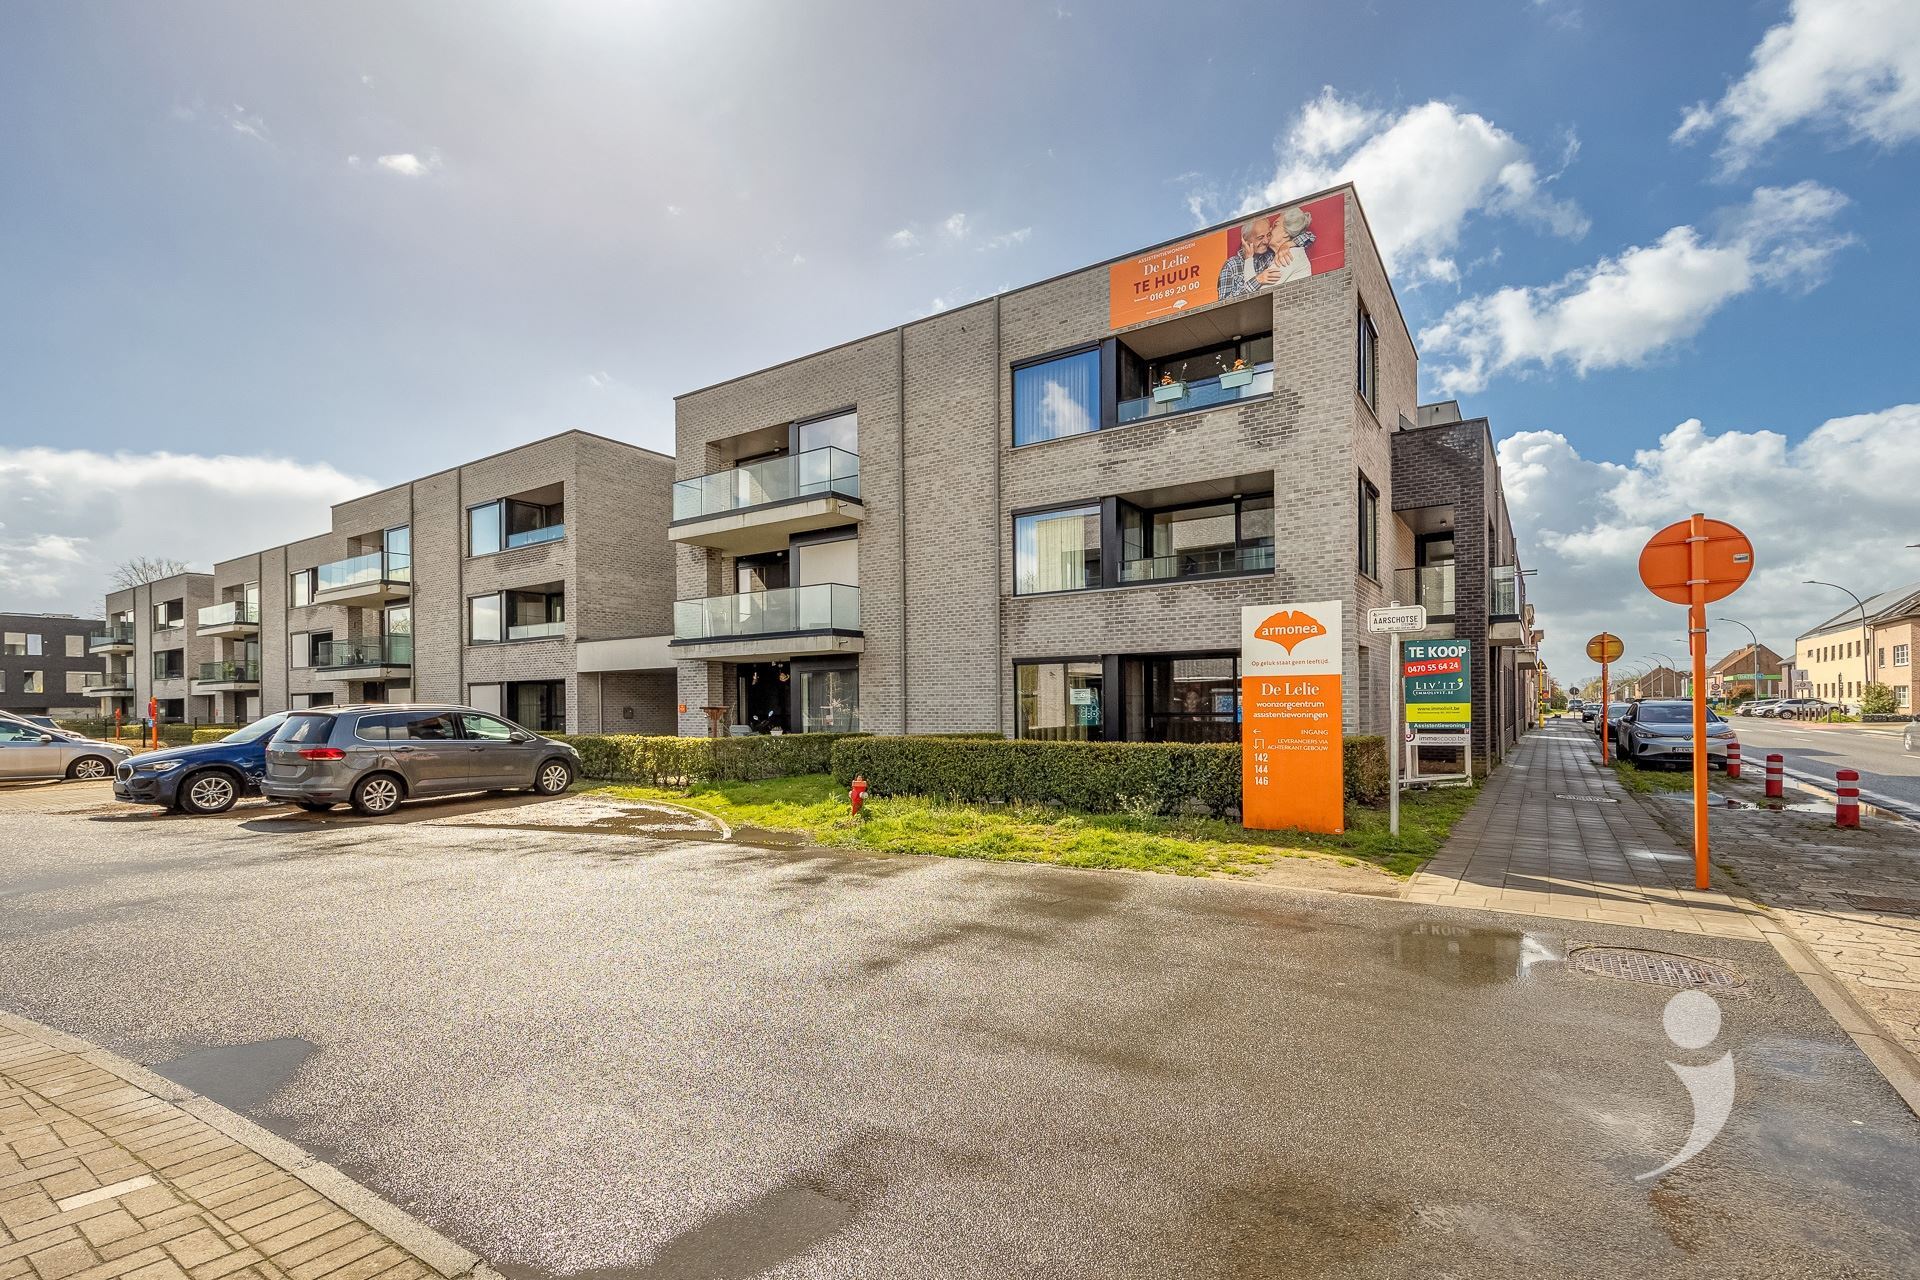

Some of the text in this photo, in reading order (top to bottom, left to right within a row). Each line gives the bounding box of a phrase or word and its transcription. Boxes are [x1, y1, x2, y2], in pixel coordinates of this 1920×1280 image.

[1144, 254, 1189, 275] De Lelie
[1134, 265, 1200, 294] TE HUUR
[1150, 281, 1200, 301] 016 89 20 00
[1373, 615, 1419, 625] AARSCHOTSE
[1261, 625, 1318, 636] armonea
[1408, 646, 1467, 658] TE KOOP
[1260, 659, 1275, 667] geluk
[1292, 659, 1306, 667] geen
[1407, 665, 1426, 673] 0470
[1438, 662, 1448, 670] 64
[1449, 661, 1459, 670] 24
[1261, 682, 1320, 696] De Lelie
[1256, 701, 1325, 710] woonzorgcentrum
[1253, 711, 1329, 721] assistentiewoningen
[1254, 753, 1268, 762] 142
[1254, 764, 1269, 774] 144
[1254, 776, 1269, 786] 146
